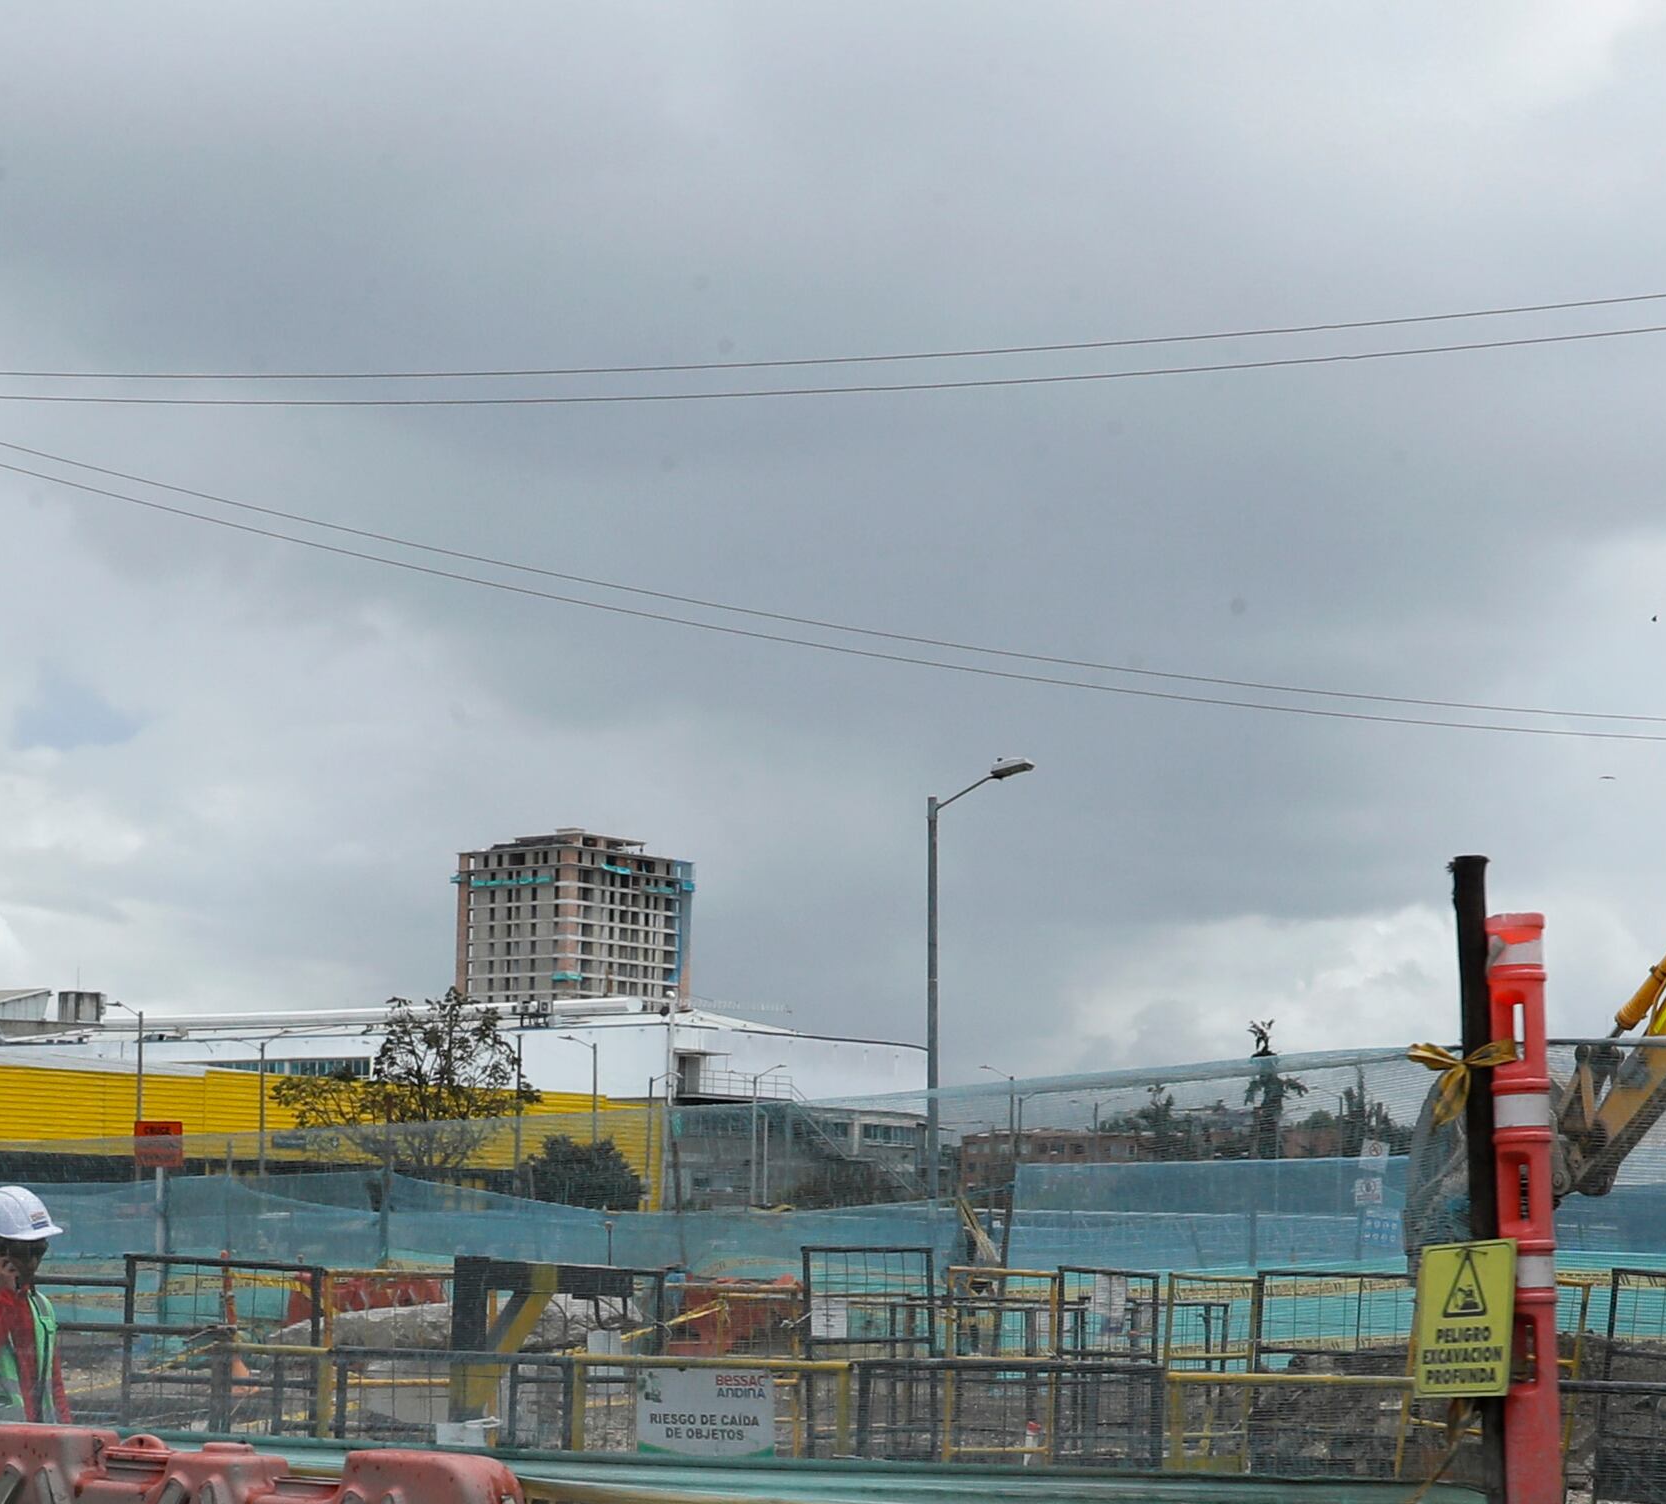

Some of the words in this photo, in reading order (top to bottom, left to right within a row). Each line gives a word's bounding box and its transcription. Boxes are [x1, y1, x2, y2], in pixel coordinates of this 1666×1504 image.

[1435, 1326, 1492, 1344] PELIGRO
[1422, 1346, 1503, 1365] EXCAVACION
[1425, 1368, 1497, 1385] PROFUNDA
[649, 1413, 696, 1425] RIESGO
[700, 1414, 717, 1426] DE
[721, 1412, 760, 1427] CAÍDA
[665, 1427, 682, 1439] DE
[686, 1428, 744, 1441] OBJETOS
